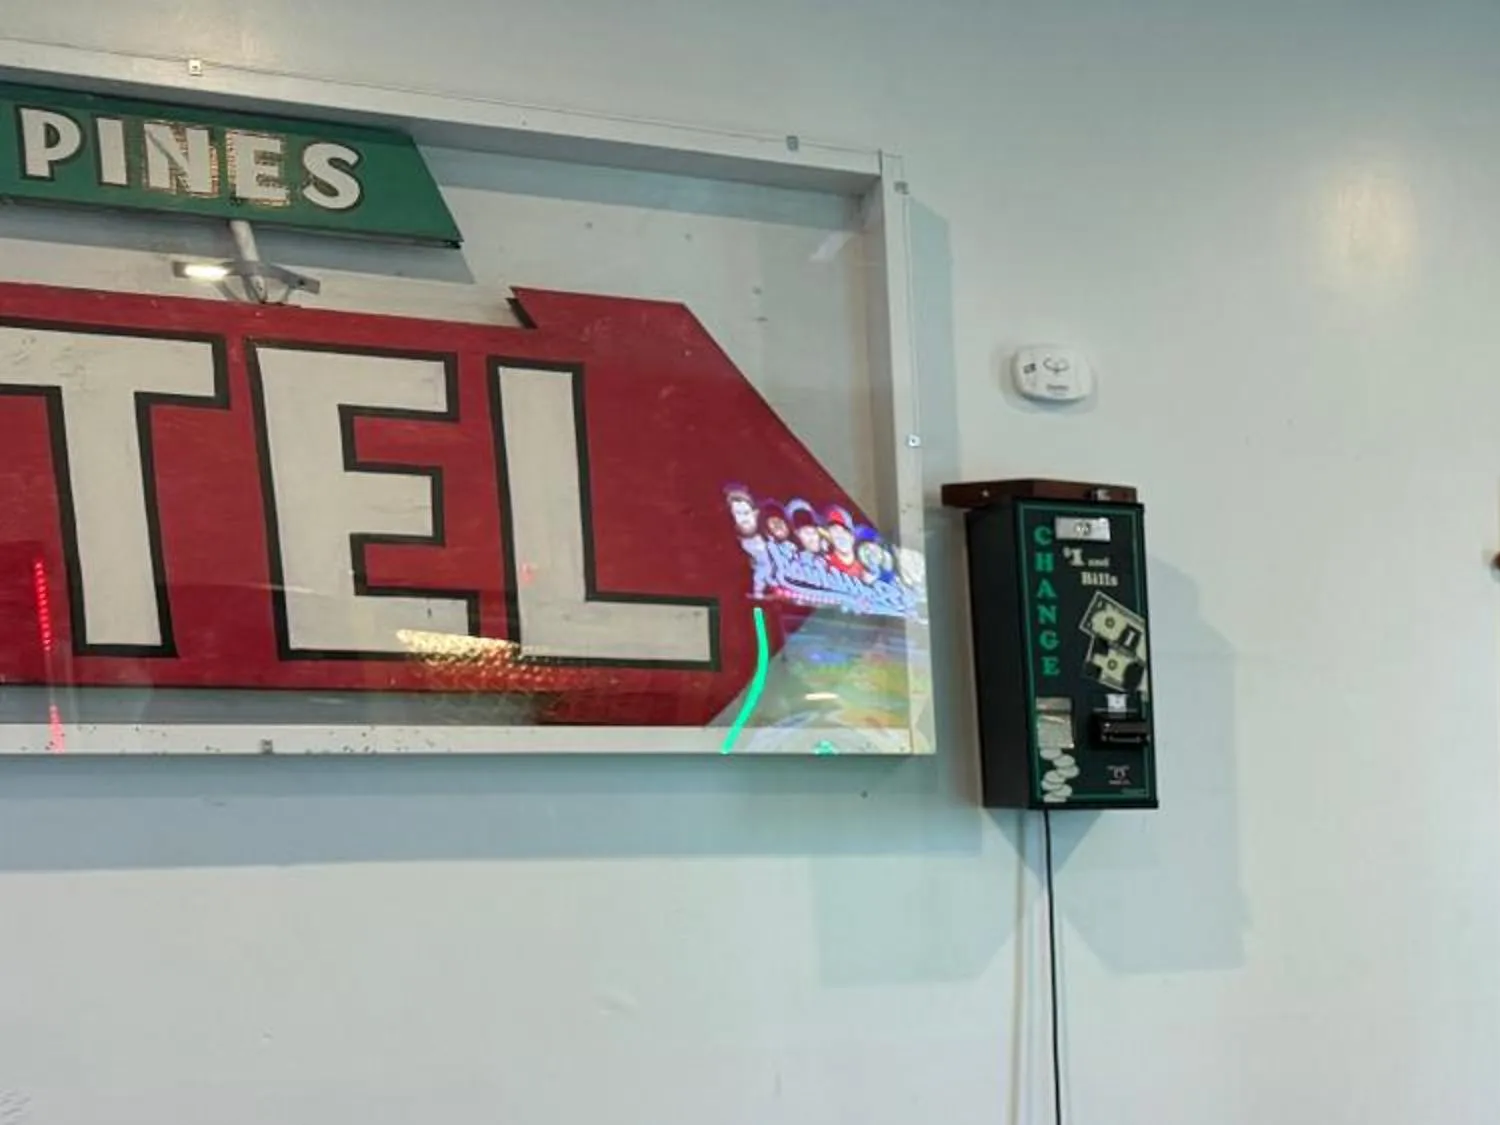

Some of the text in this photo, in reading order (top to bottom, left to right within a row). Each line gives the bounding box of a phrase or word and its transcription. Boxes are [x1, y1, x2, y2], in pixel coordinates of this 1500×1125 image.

[18, 106, 362, 210] PINES
[0, 320, 716, 668] TEL
[1034, 525, 1060, 676] CHANGE
[1081, 571, 1119, 587] Bills
